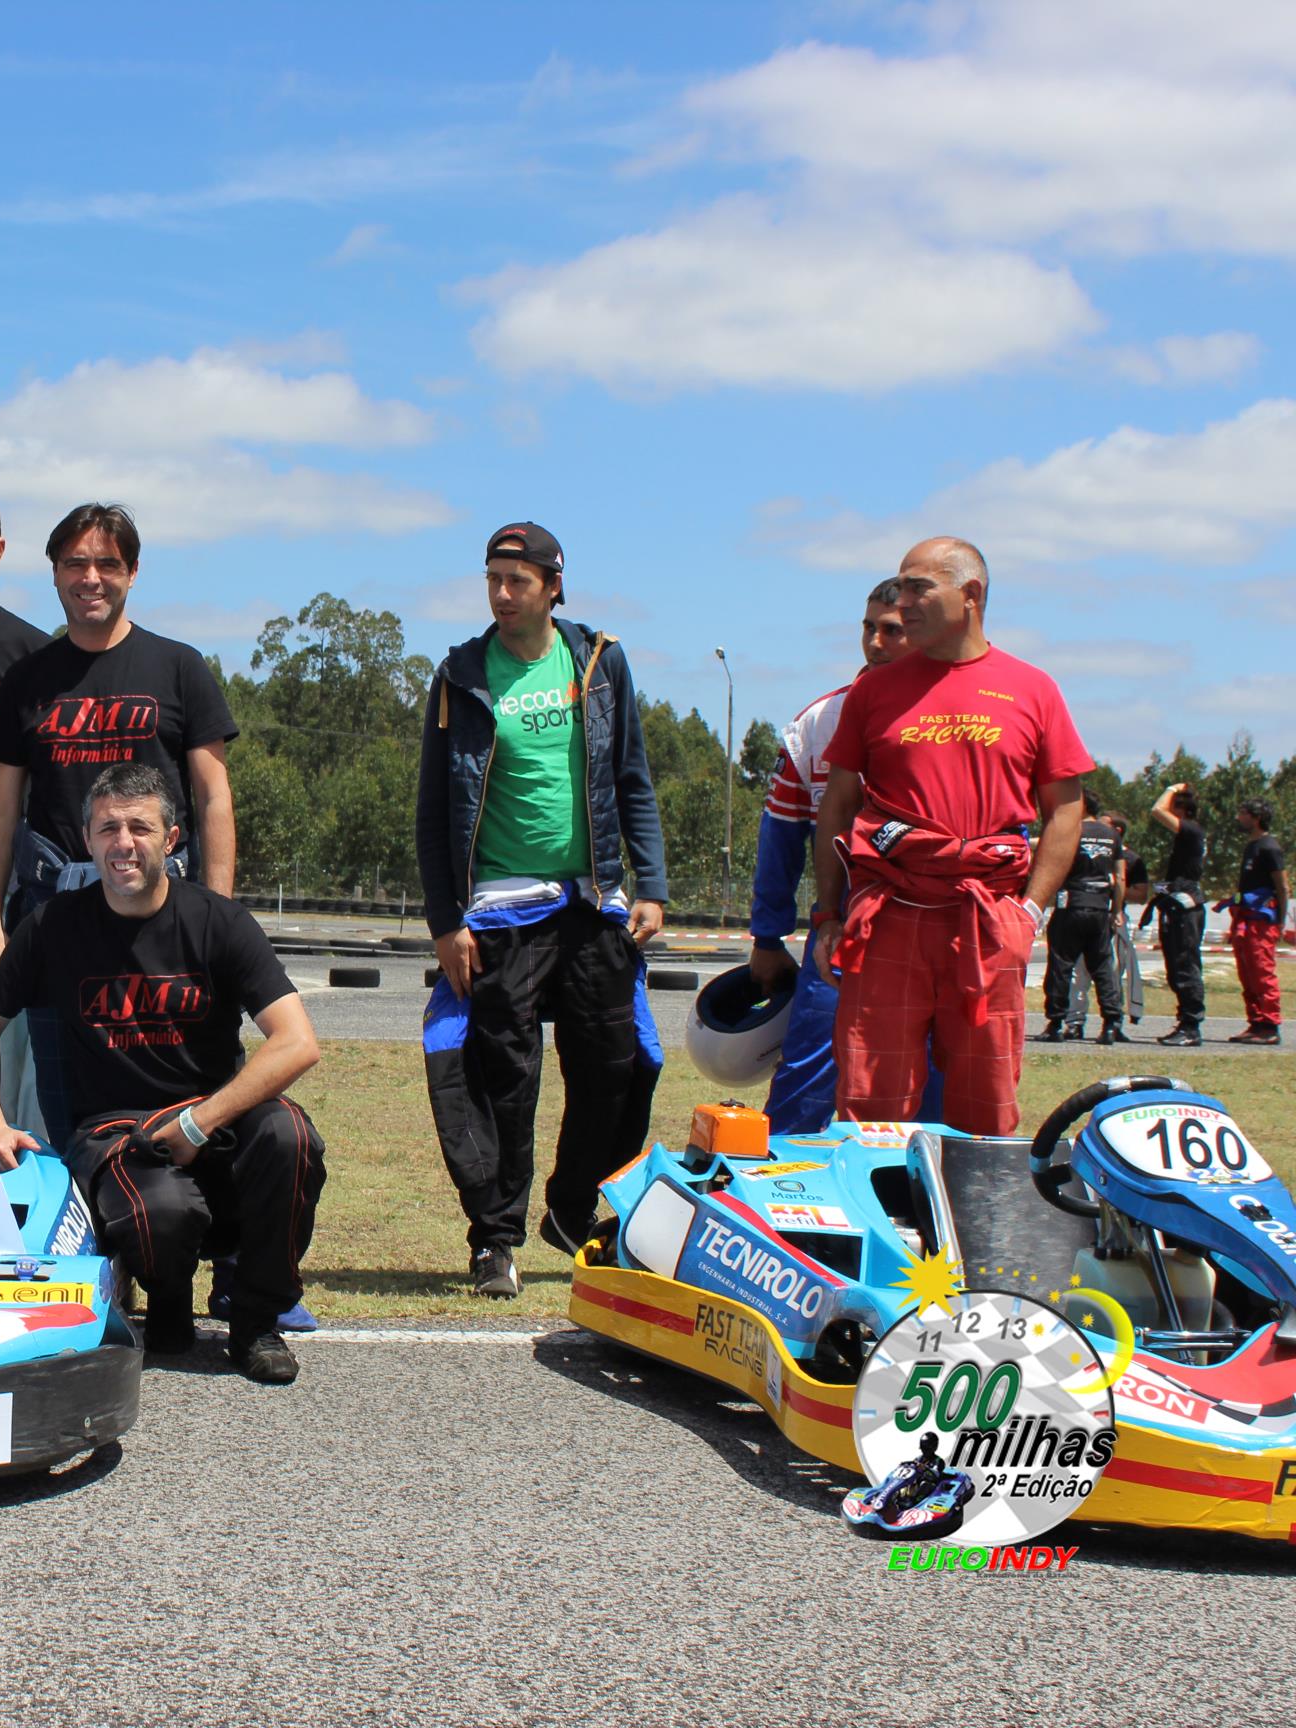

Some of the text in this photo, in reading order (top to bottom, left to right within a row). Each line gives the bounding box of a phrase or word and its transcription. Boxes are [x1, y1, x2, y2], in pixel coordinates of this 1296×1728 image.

[520, 689, 564, 711] coq
[37, 697, 153, 737] AJM II
[521, 704, 584, 735] sport
[919, 714, 991, 724] FAST TEAM
[900, 724, 1002, 747] RACING
[51, 744, 134, 768] Informática
[84, 974, 202, 1020] AJM II
[1122, 1107, 1221, 1123] EUROINDY
[1146, 1118, 1248, 1171] 160
[771, 1191, 824, 1201] Martos
[776, 1216, 817, 1226] refil
[696, 1216, 824, 1319] TECNIROLO
[698, 1261, 736, 1290] ENGENHARIA
[13, 1282, 84, 1304] eni
[695, 1303, 735, 1343] FAST
[705, 1338, 762, 1378] RACING
[1112, 1376, 1195, 1416] RON
